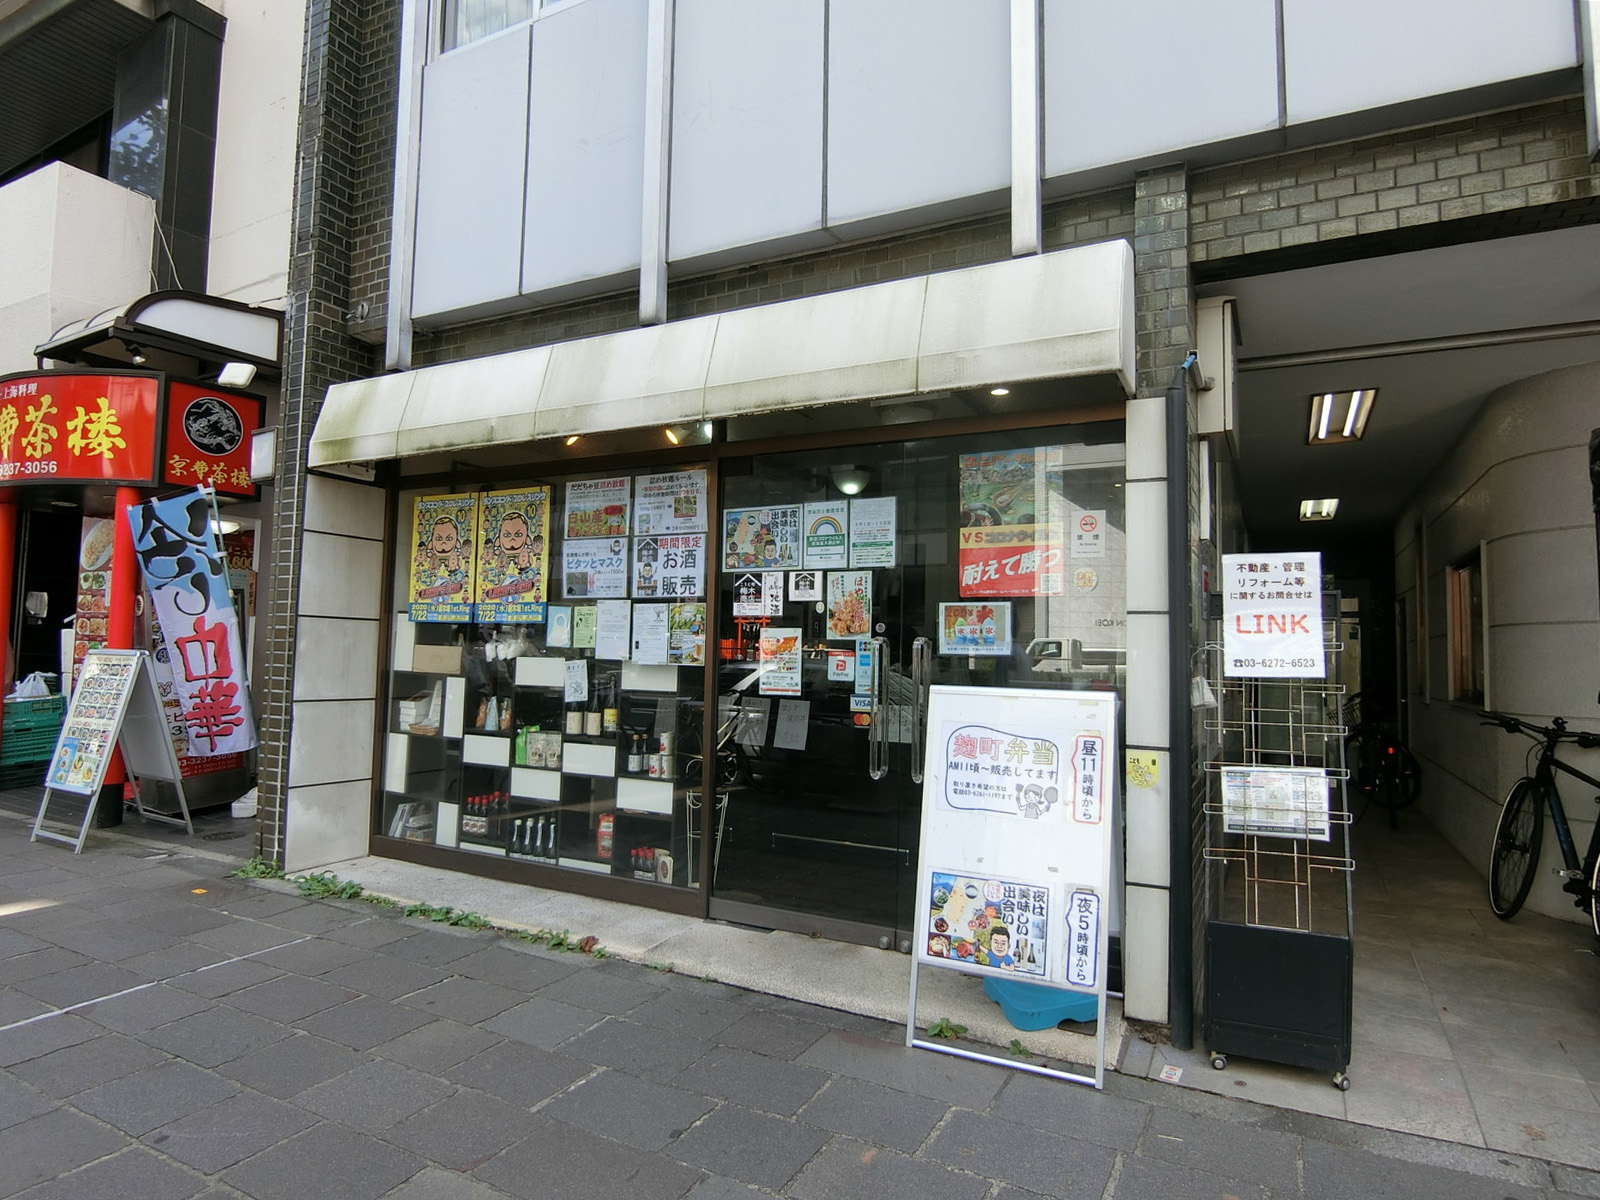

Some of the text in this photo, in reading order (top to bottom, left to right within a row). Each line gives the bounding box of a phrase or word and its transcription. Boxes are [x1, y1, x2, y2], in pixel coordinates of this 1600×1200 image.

[770, 510, 780, 538] 出会い
[779, 510, 789, 543] 美味しい
[789, 509, 798, 527] 夜は
[658, 536, 702, 550] 期間限定
[663, 549, 696, 570] お酒
[962, 549, 1061, 587] 耐えて勝つ
[1236, 562, 1305, 573] 不動産・管理
[662, 575, 697, 595] 販売
[1238, 576, 1305, 588] リフォーム等
[1229, 591, 1313, 600] に関するお問合せは
[411, 610, 427, 621] 7/22
[479, 610, 496, 621] 7/22
[1235, 614, 1310, 634] LINK
[1244, 658, 1316, 668] 03-6272-6523
[953, 733, 1054, 766] 麹町弁当
[953, 780, 1007, 792] 取り置き希望の方は
[1081, 740, 1098, 820] 昼11時頃から
[1002, 886, 1016, 926] 出会い
[1016, 887, 1031, 936] 美味しい
[1032, 889, 1046, 918] 夜は
[1075, 897, 1093, 981] 夜5時頃から
